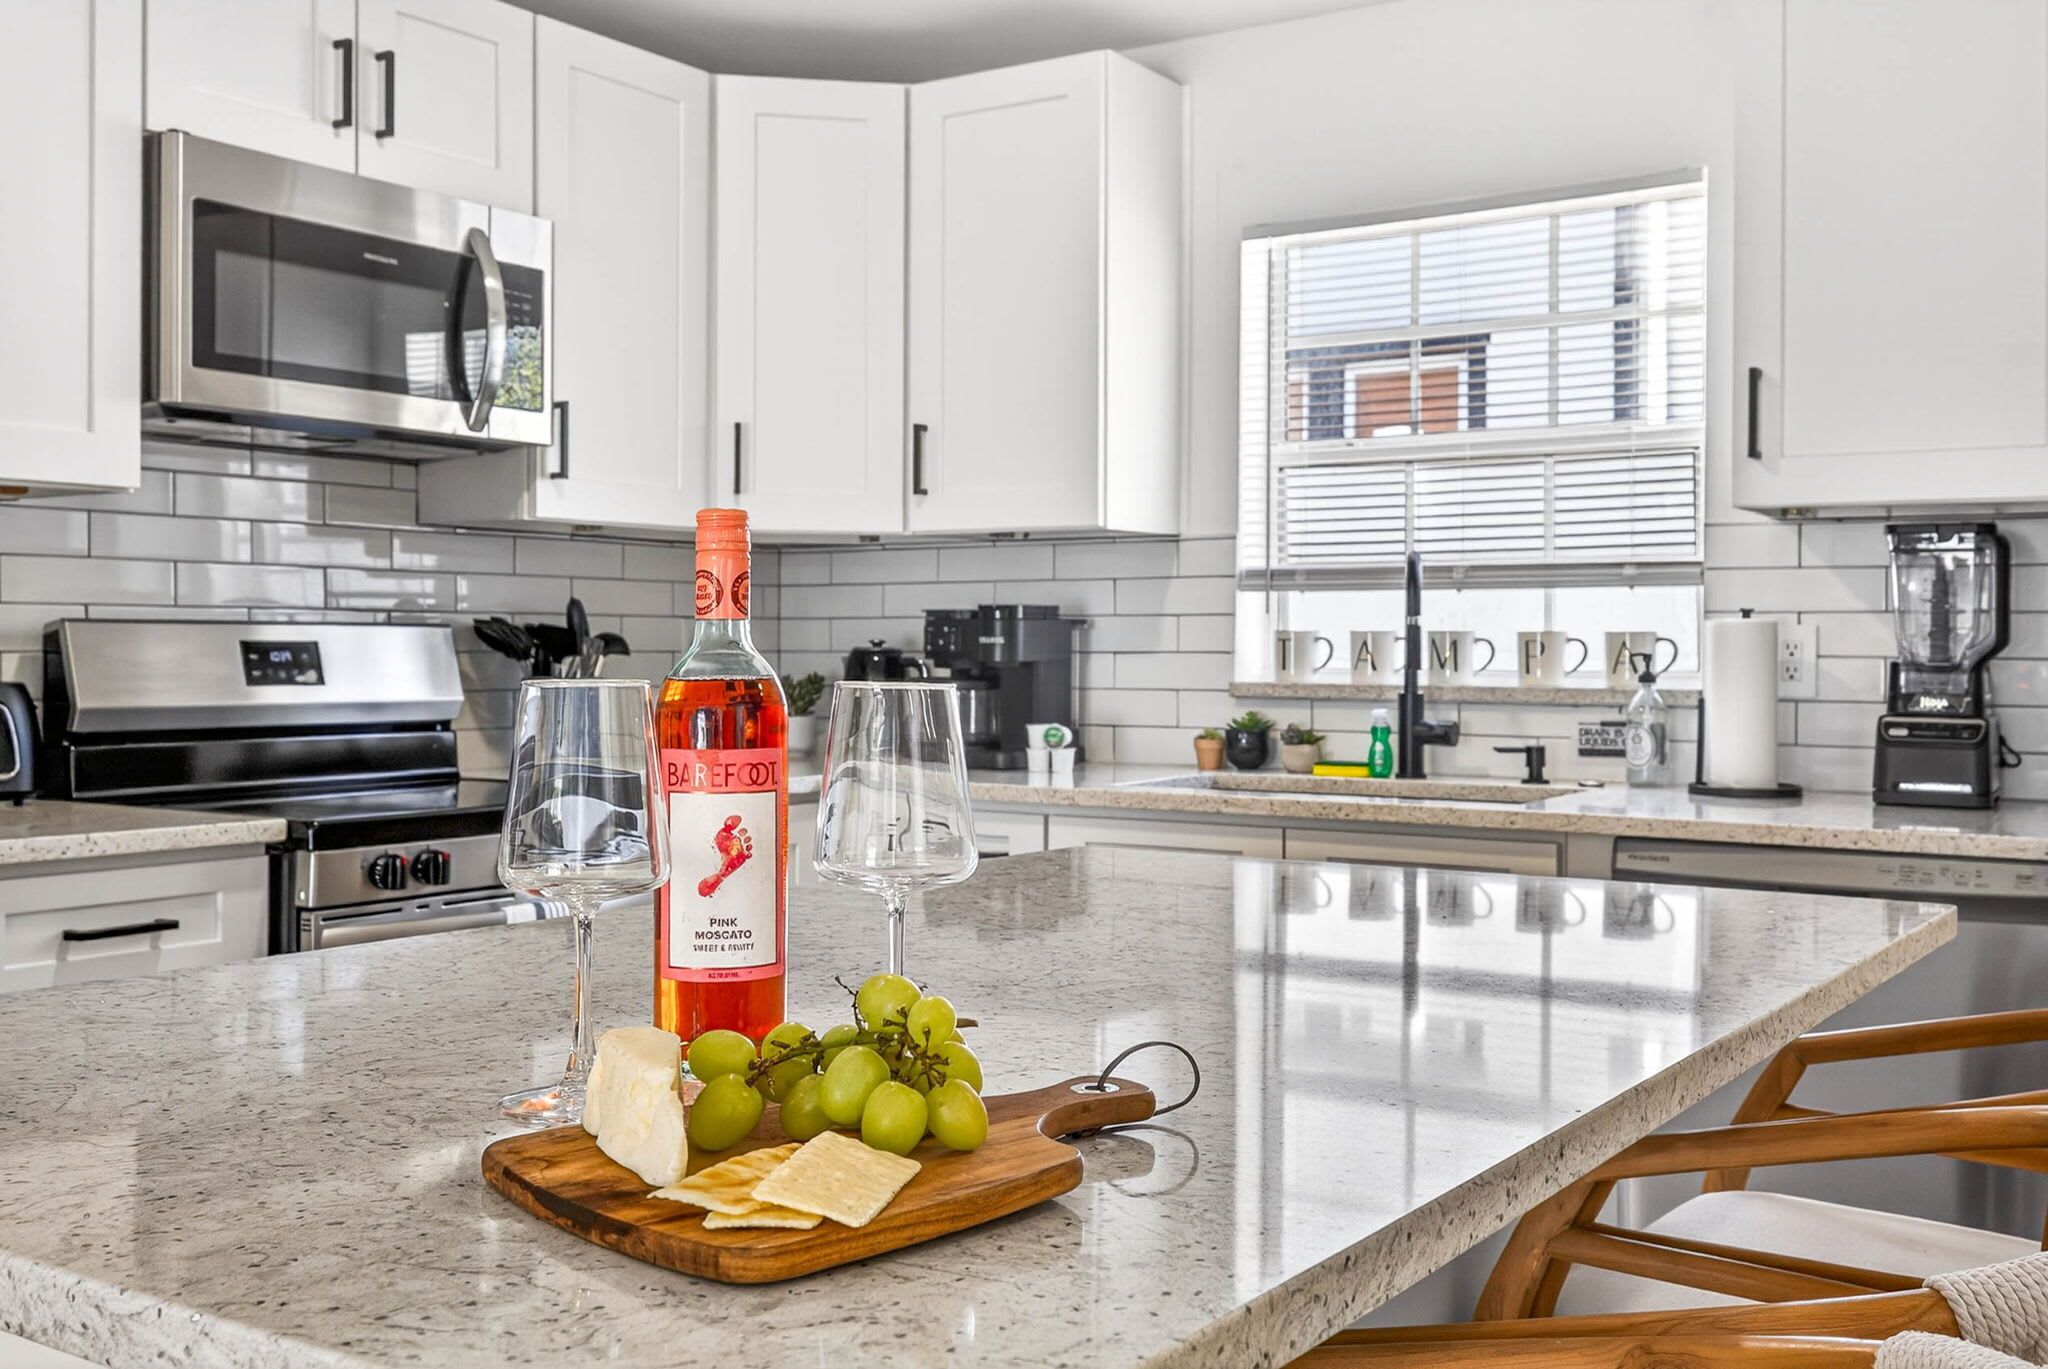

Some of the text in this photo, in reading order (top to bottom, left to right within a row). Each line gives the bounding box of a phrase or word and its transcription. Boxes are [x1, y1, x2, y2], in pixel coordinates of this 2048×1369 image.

[667, 761, 777, 788] BAREFOOT
[709, 917, 738, 928] PINK
[694, 929, 753, 940] MOSCATO
